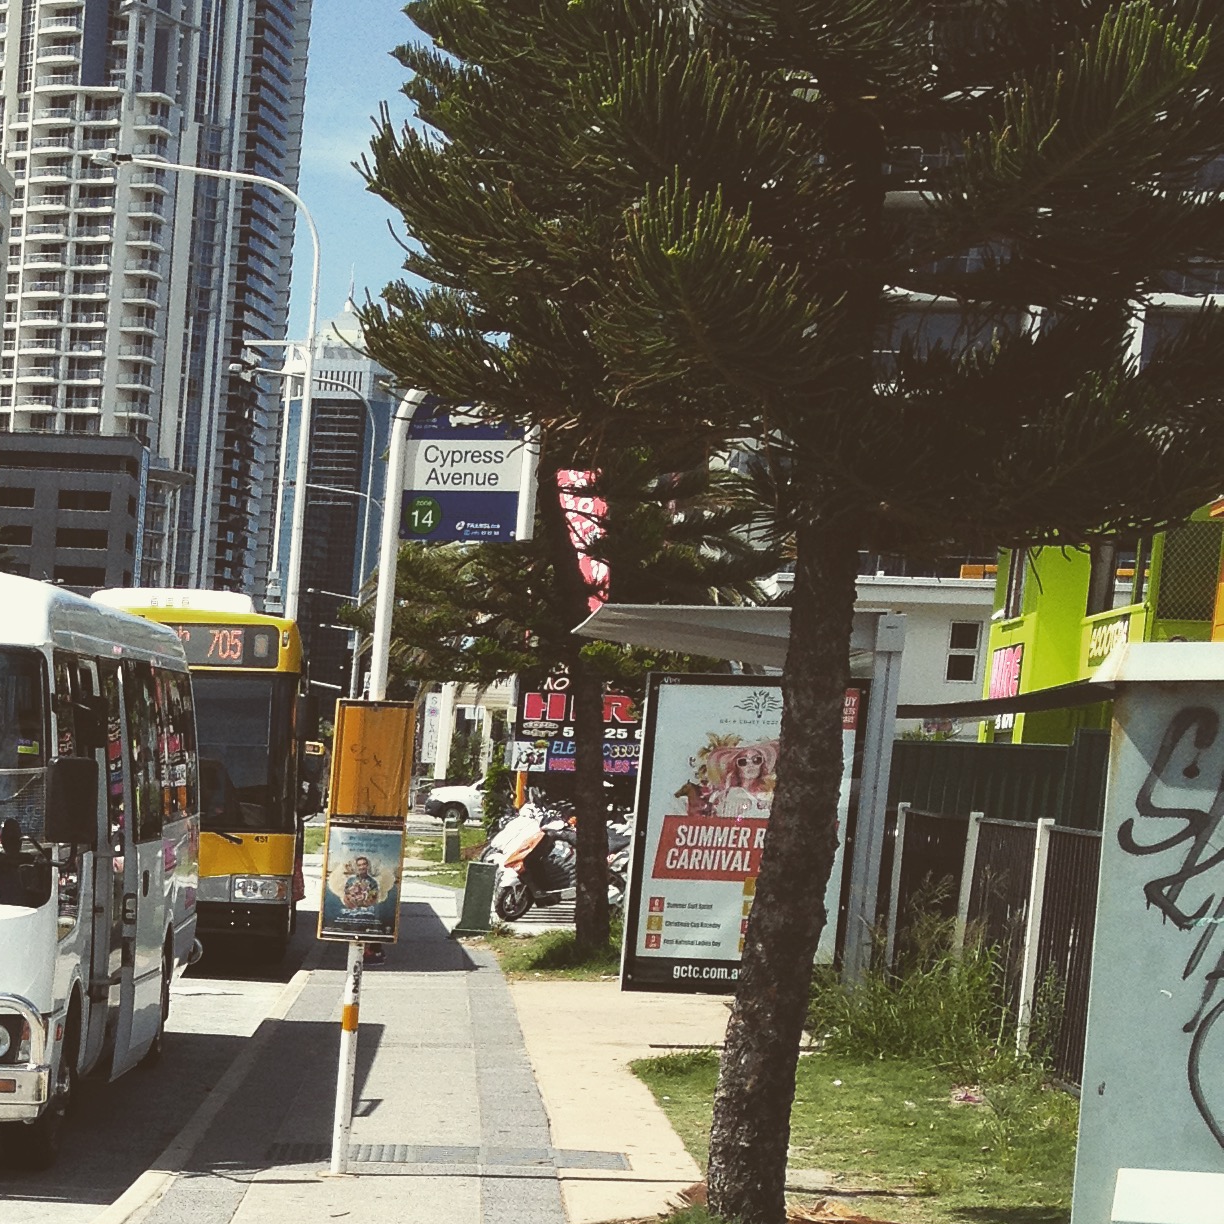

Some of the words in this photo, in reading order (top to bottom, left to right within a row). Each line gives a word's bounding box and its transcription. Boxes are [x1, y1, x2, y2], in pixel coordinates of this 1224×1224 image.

[424, 445, 504, 468] Cypress
[425, 468, 499, 487] Avenue
[411, 509, 434, 528] 14
[207, 629, 243, 659] 705
[675, 825, 751, 849] SUMMER
[665, 848, 751, 872] CARNIVAL
